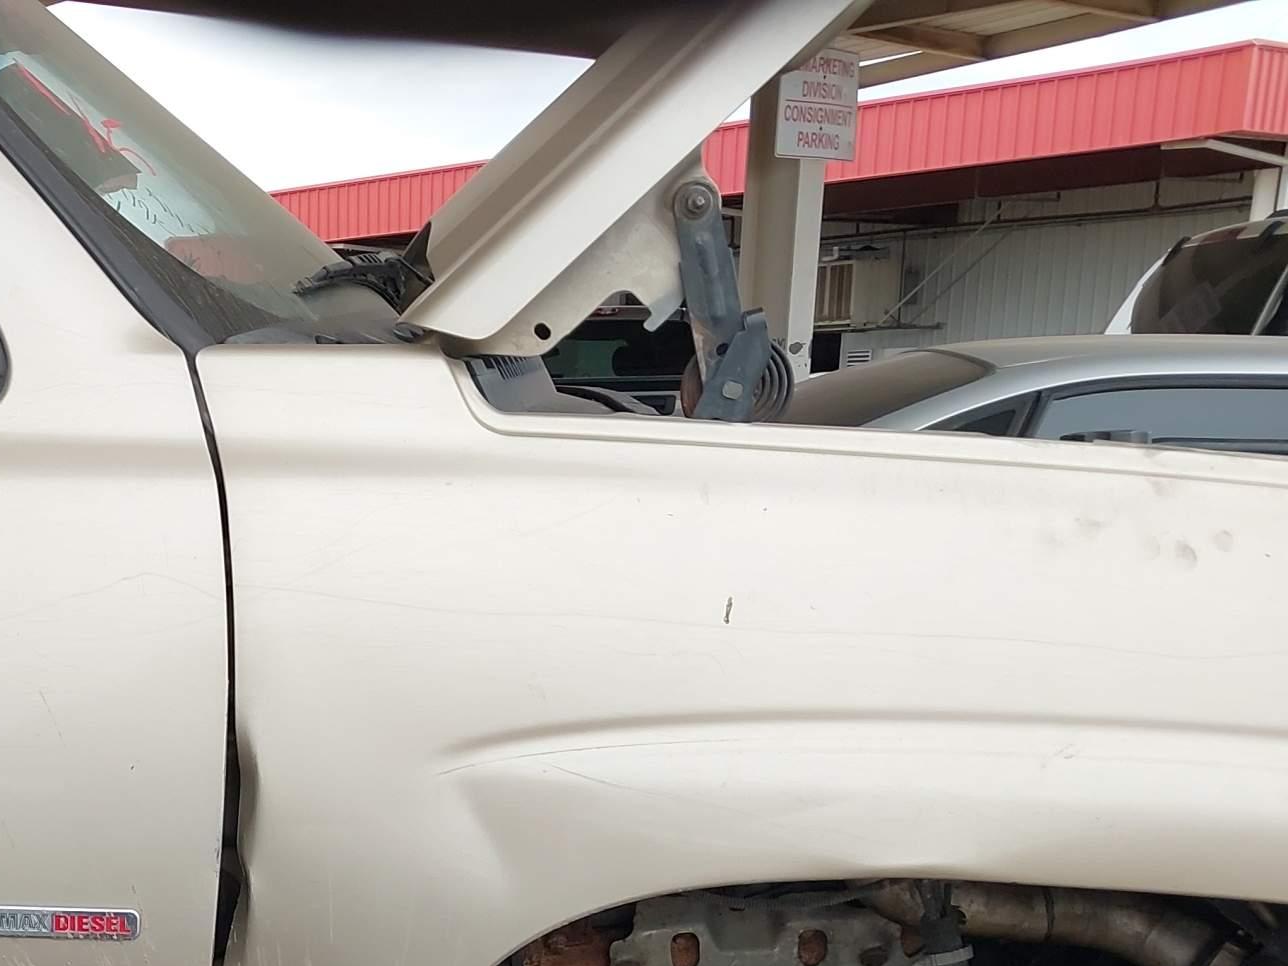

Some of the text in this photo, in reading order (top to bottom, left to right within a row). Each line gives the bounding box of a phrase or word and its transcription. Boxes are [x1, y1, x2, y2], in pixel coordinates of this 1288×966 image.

[802, 81, 844, 100] DIVISION
[784, 104, 852, 127] CONSIGNMENT
[796, 131, 840, 150] PARKING
[54, 913, 132, 934] DIESEL
